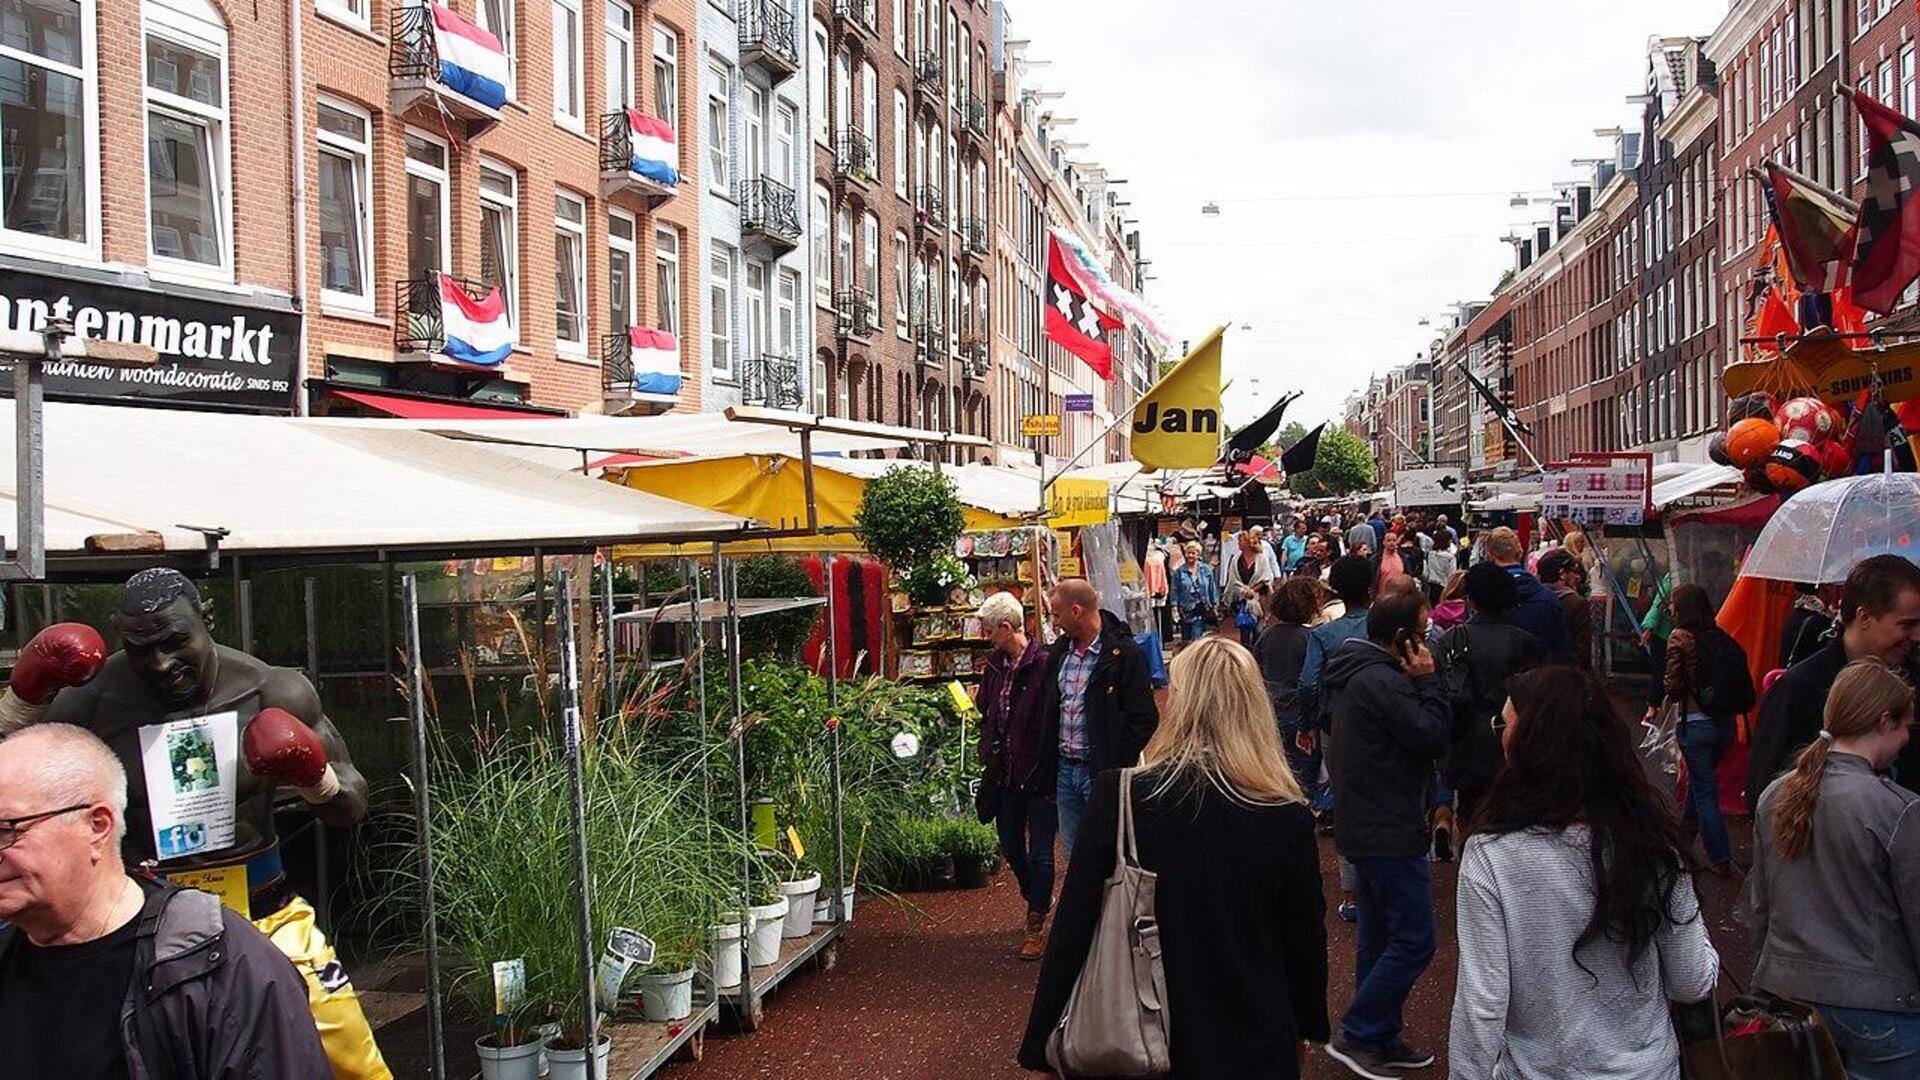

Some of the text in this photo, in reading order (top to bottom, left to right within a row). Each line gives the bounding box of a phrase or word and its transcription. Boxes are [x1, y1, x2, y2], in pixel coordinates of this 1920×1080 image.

[119, 363, 244, 391] woondecoratie
[246, 377, 270, 391] SINDS
[271, 380, 289, 392] 1952
[1133, 401, 1218, 434] Jan
